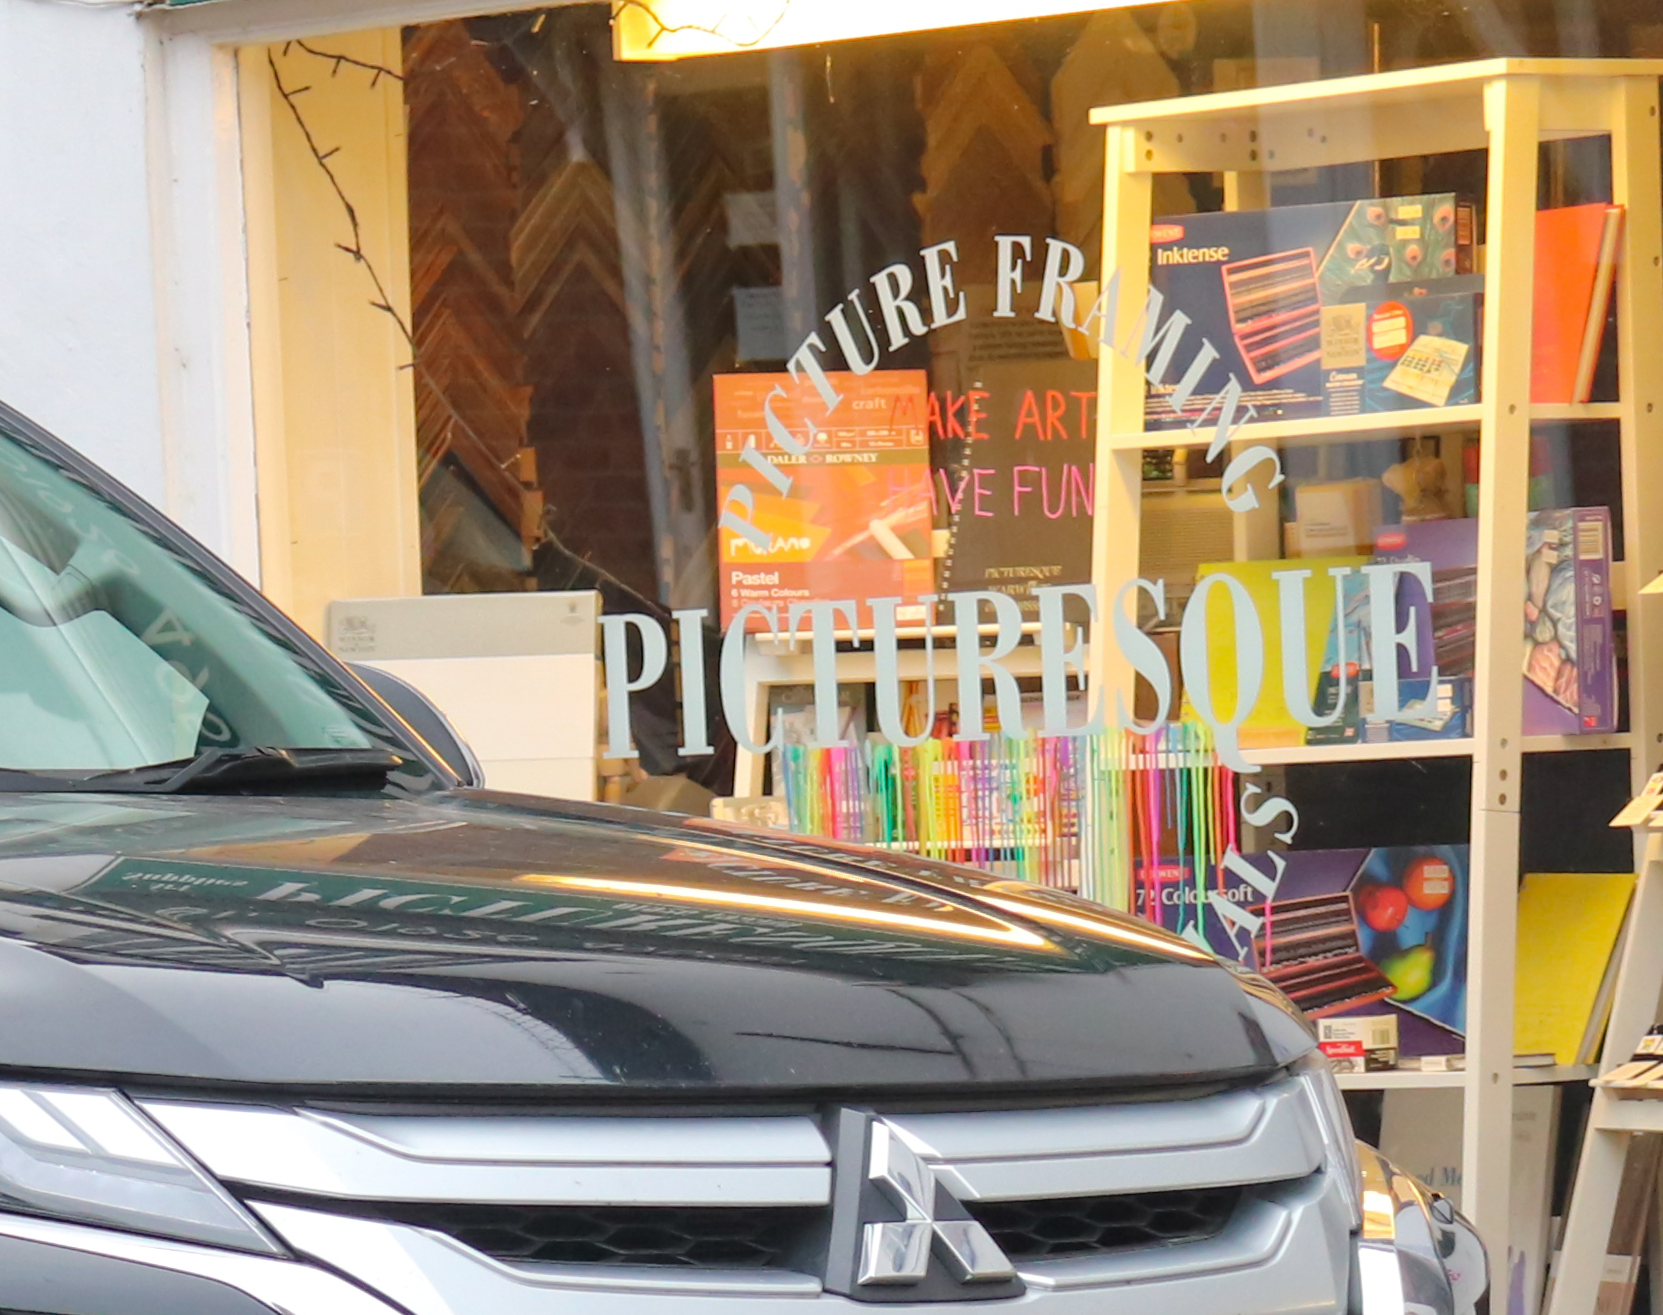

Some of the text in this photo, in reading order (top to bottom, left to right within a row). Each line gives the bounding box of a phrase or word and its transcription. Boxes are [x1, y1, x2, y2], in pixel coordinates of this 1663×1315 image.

[1157, 245, 1230, 266] Inktense
[718, 235, 1286, 553] PICTURE FRAMING
[852, 398, 887, 410] craft
[889, 389, 991, 440] MAKE
[1015, 388, 1097, 441] ART
[766, 452, 878, 464] DALER ROWNEY
[1013, 462, 1094, 519] FUN
[731, 571, 780, 586] Pastel
[740, 588, 770, 598] Warm
[771, 587, 810, 598] Colours
[597, 560, 1439, 775] PICTURESQUE
